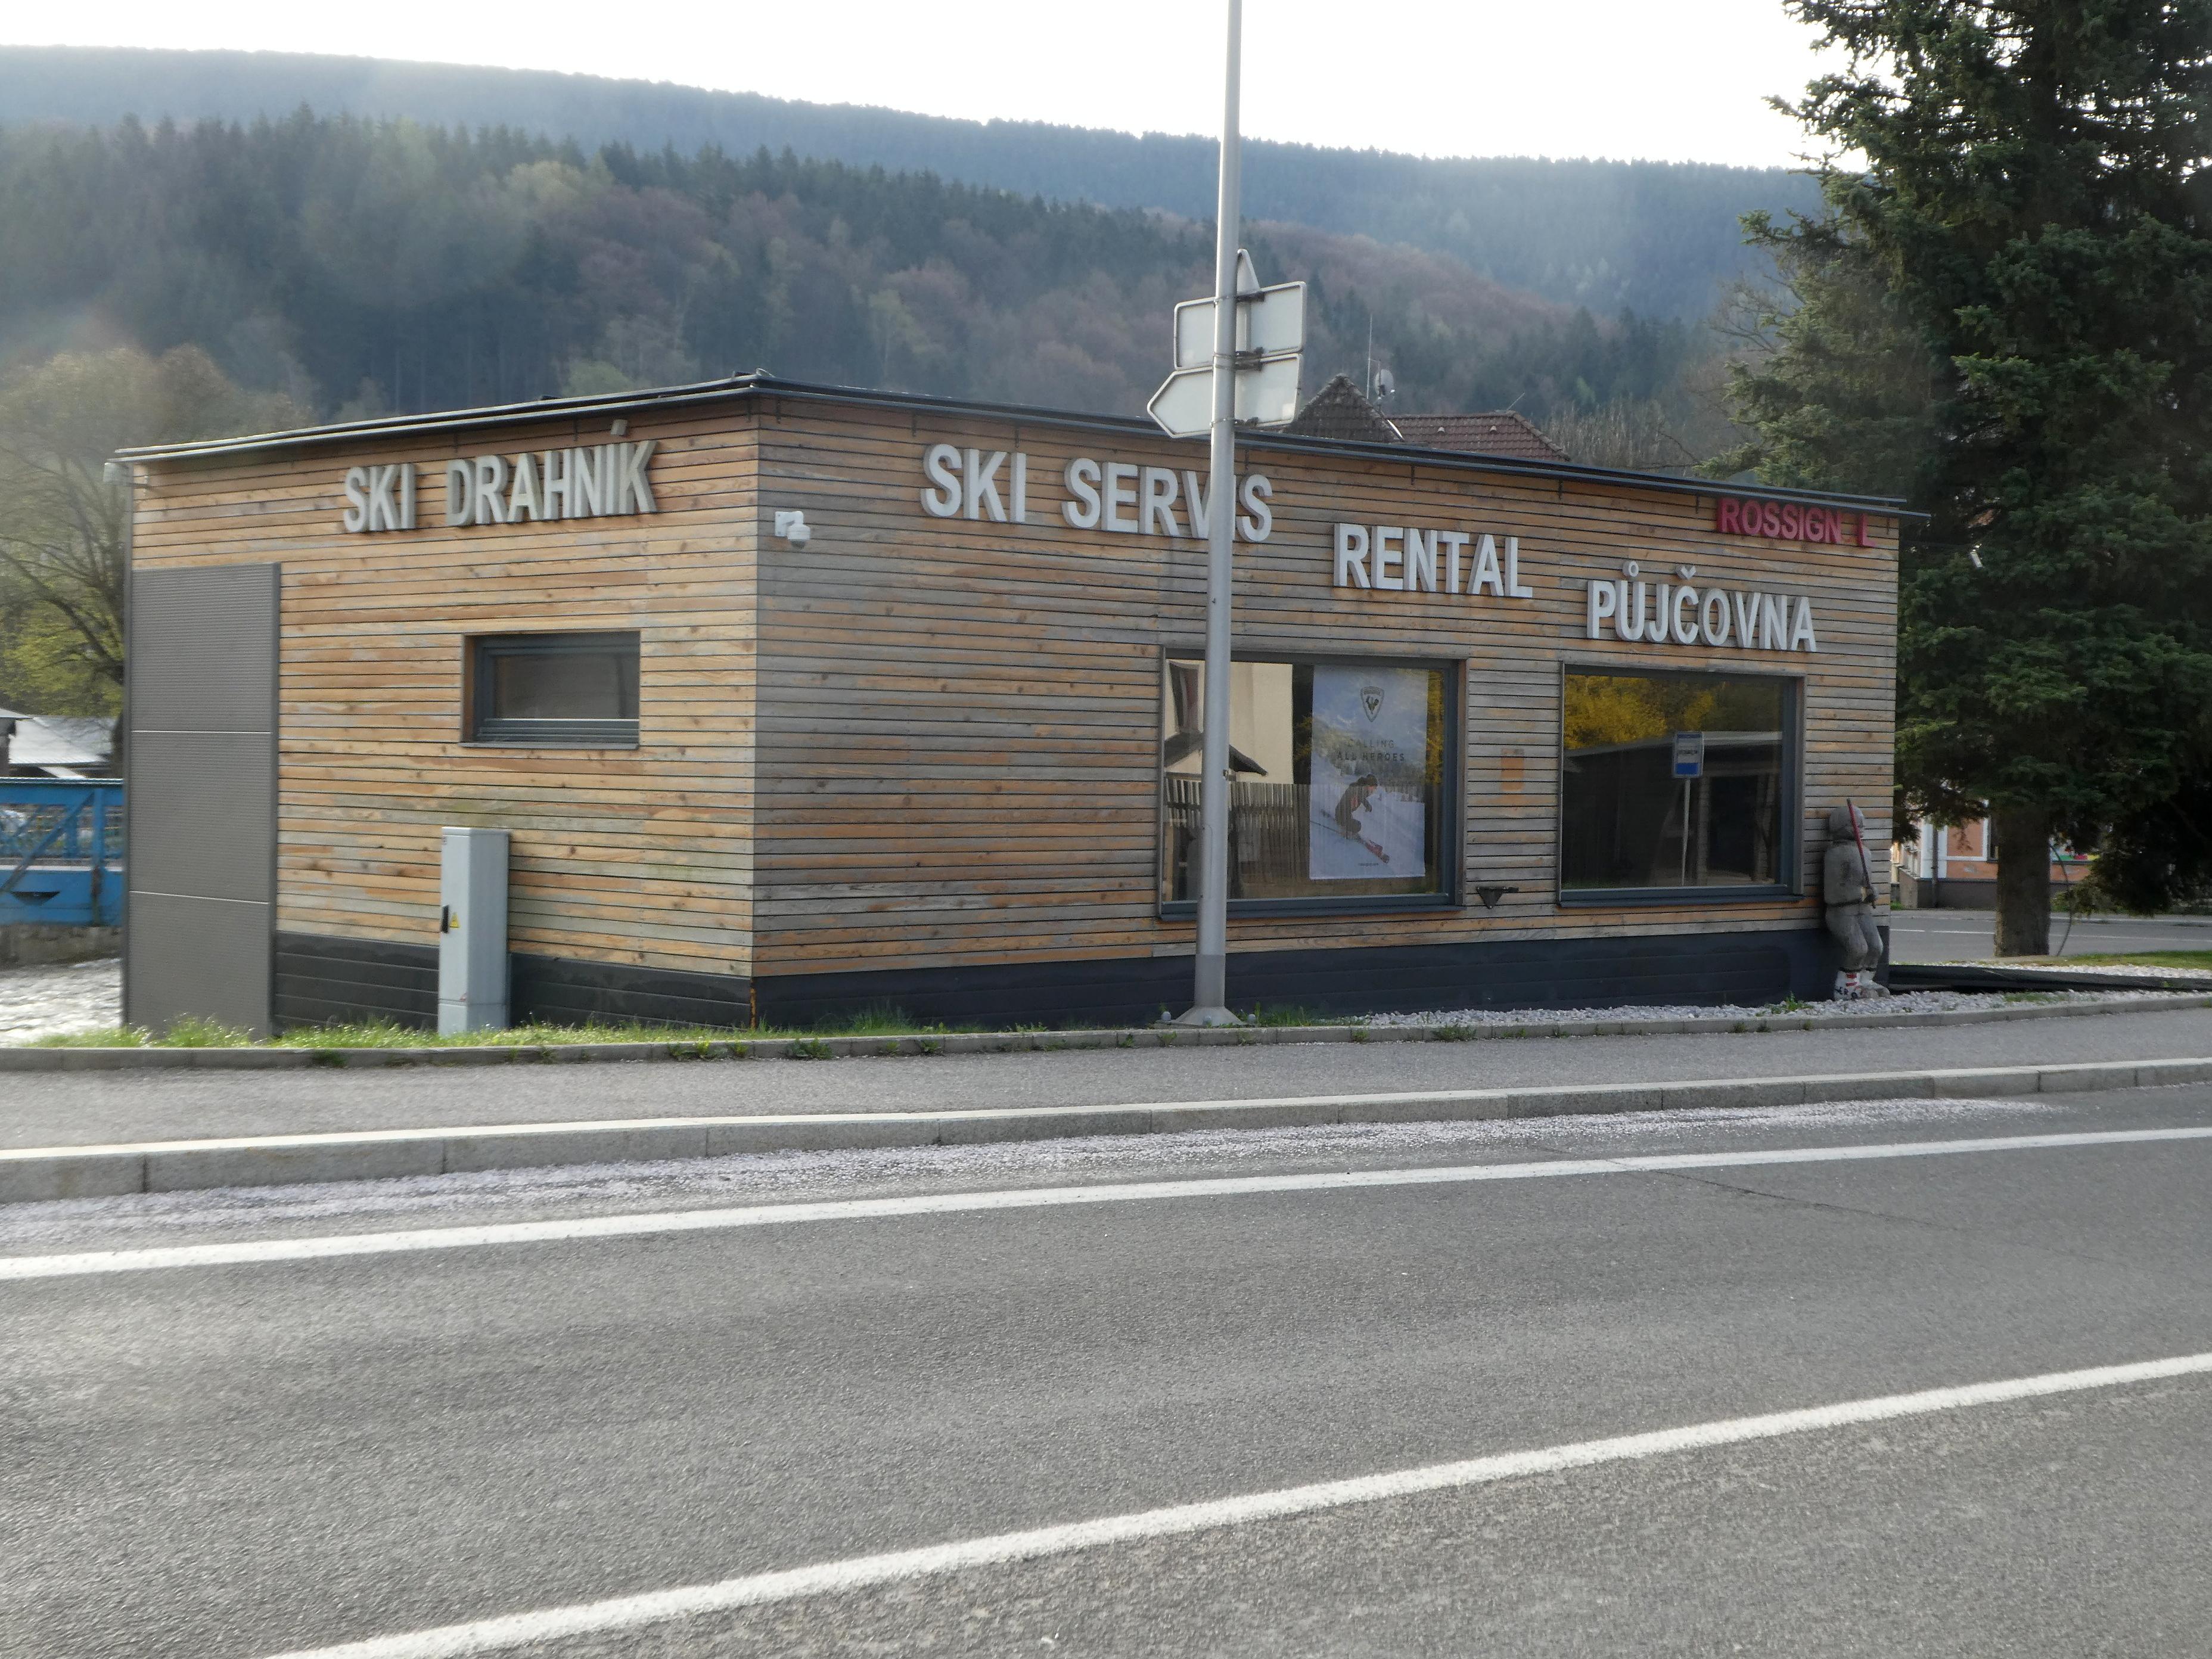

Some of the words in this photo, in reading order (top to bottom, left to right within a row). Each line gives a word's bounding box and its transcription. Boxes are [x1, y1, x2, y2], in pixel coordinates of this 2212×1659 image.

[344, 463, 415, 532] SKI
[446, 440, 657, 526] DRAHNIK
[920, 443, 1026, 523] SKI
[1062, 458, 1272, 543] SERVS
[1716, 497, 1876, 547] ROSSIGNL
[1334, 523, 1533, 598] RENTAL
[1587, 561, 1816, 652] PŮJČOVNA
[1362, 753, 1405, 762] HEROES
